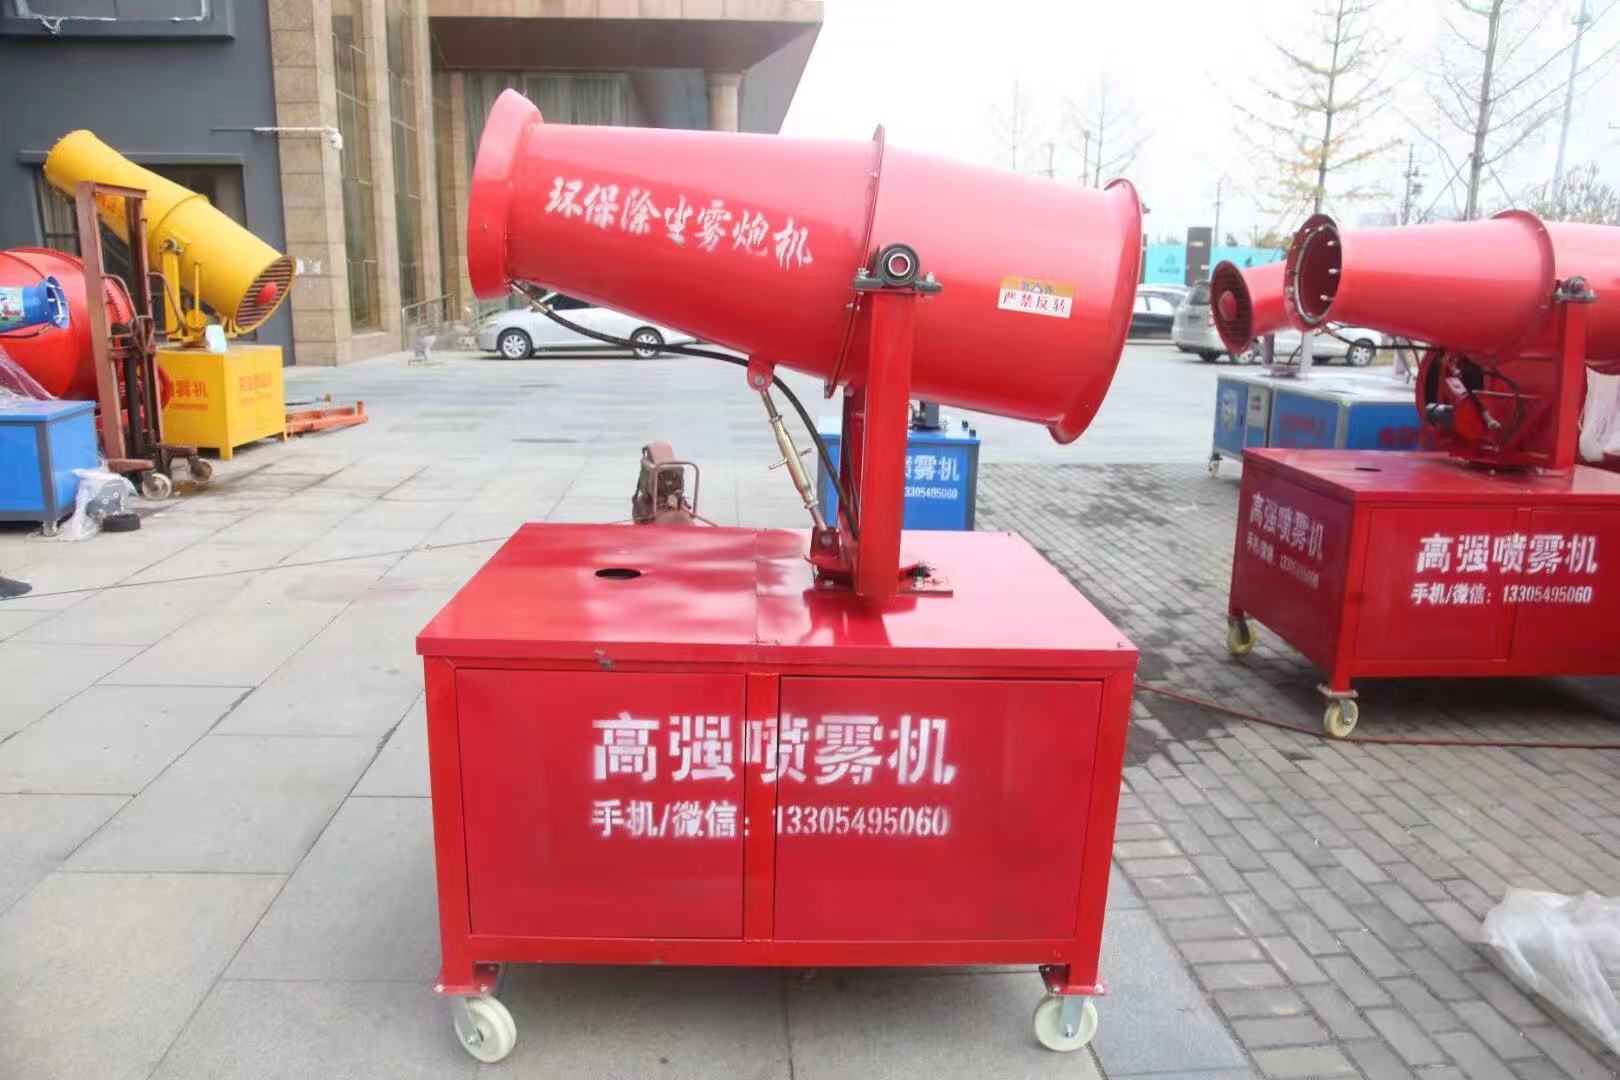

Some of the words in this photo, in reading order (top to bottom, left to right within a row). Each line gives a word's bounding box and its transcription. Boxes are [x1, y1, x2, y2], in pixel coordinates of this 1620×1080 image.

[545, 176, 813, 271] 环保除尘雾炮机
[1003, 291, 1065, 313] 严禁反转
[1415, 532, 1599, 575] 高强喷雾机
[591, 711, 957, 785] 高强喷雾机
